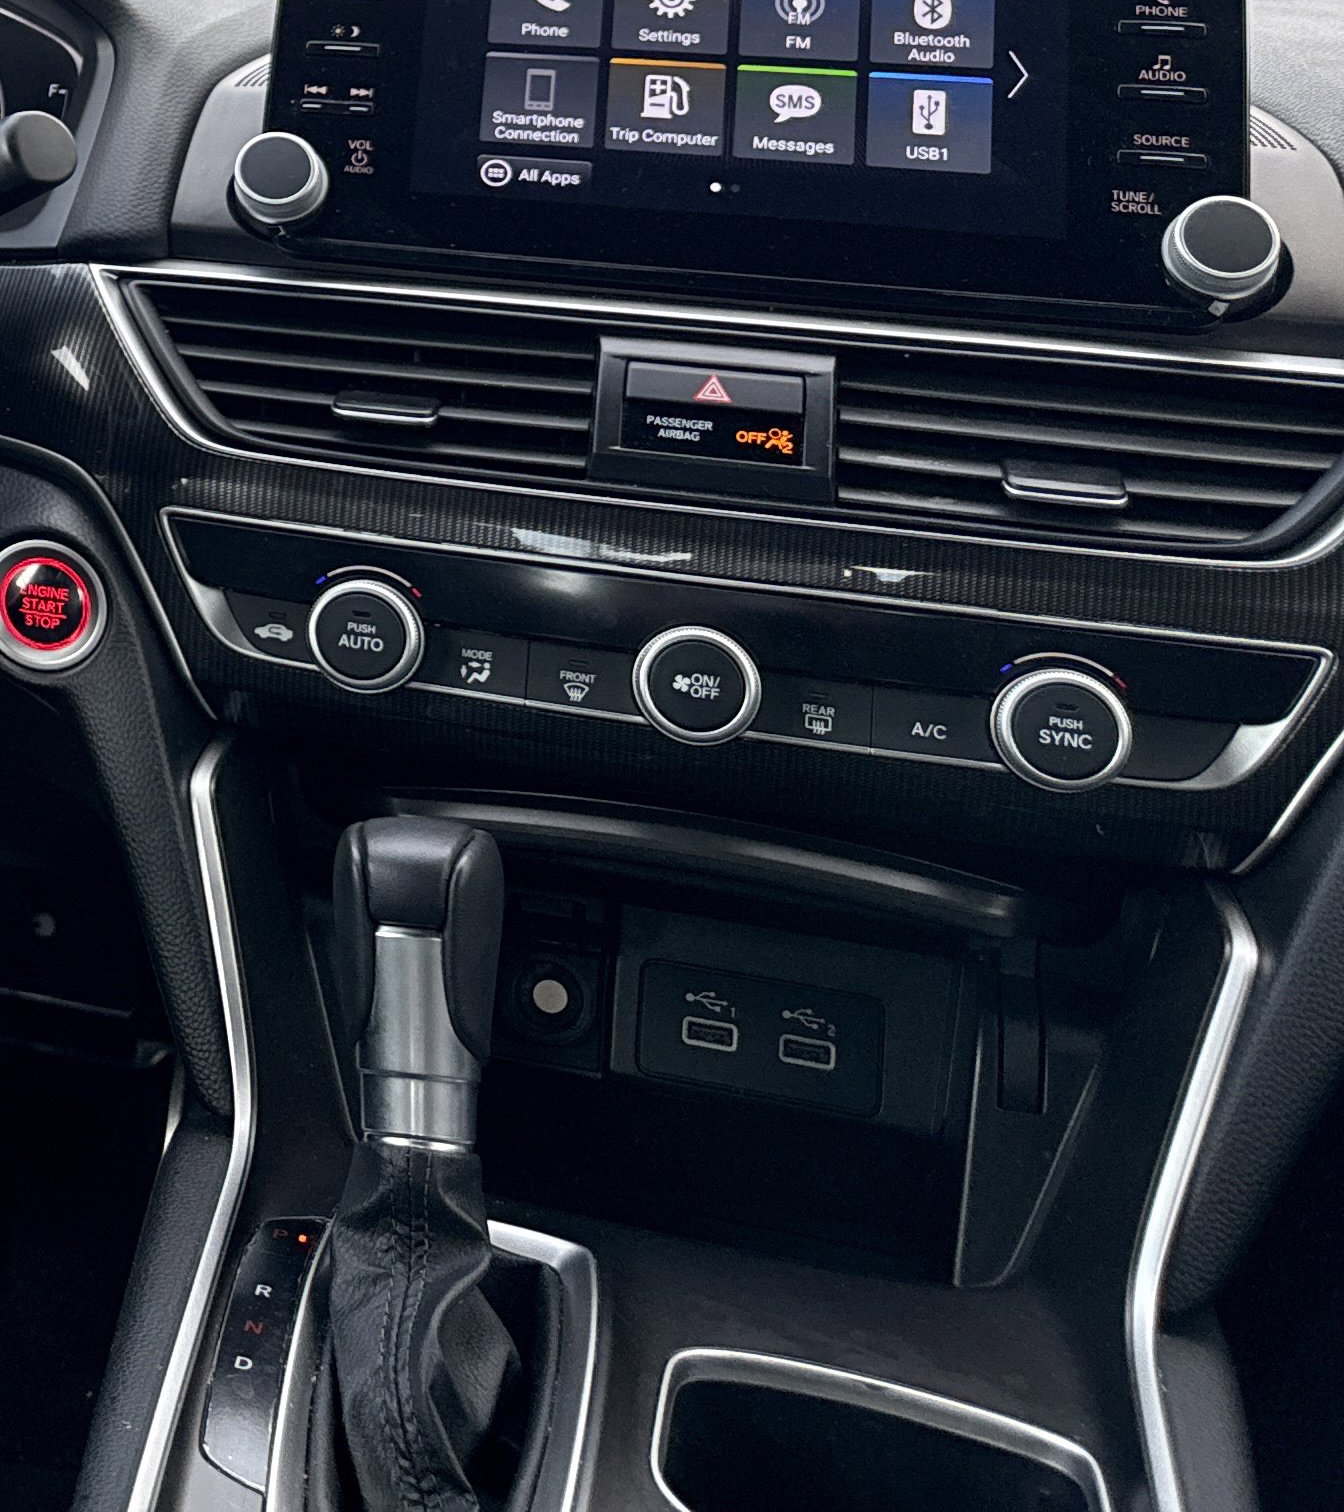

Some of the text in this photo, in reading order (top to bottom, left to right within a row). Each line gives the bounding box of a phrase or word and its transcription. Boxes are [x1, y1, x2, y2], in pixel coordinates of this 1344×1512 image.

[1135, 5, 1188, 18] PHONE
[521, 23, 569, 38] Phone
[638, 28, 701, 46] Settings
[786, 35, 811, 50] FM
[893, 31, 970, 48] Bluetooth
[908, 49, 955, 63] Audio
[1138, 69, 1187, 82] AUDIO
[48, 83, 61, 98] F
[775, 93, 816, 110] SMS
[492, 110, 584, 129] Smartphone
[494, 126, 579, 144] Connection
[610, 127, 719, 147] Trip Computer
[1133, 133, 1190, 148] SOURCE
[348, 139, 373, 151] VOL
[752, 135, 835, 156] Messages
[905, 145, 949, 161] USB1
[343, 164, 374, 175] AUDIO
[518, 167, 581, 187] All Apps
[1111, 189, 1154, 203] TUNE/
[1111, 201, 1162, 216] SCROLL
[646, 414, 713, 431] PASSENGER
[657, 428, 701, 442] AIRBAG
[735, 430, 768, 445] OFF
[19, 584, 70, 601] ENGINE
[22, 597, 65, 614] START
[24, 614, 60, 629] STOP
[347, 621, 377, 635] PUSH
[338, 633, 385, 653] AUTO
[461, 648, 493, 661] MODE
[559, 670, 596, 684] FRONT
[690, 673, 721, 687] ON/
[690, 686, 721, 700] OFF
[802, 703, 836, 718] REAR
[911, 722, 948, 740] A/C
[1049, 716, 1084, 731] PUSH
[1038, 728, 1093, 749] SYNC
[273, 1228, 289, 1240] P
[254, 1284, 273, 1299] R
[244, 1318, 265, 1335] N
[234, 1355, 253, 1371] D
